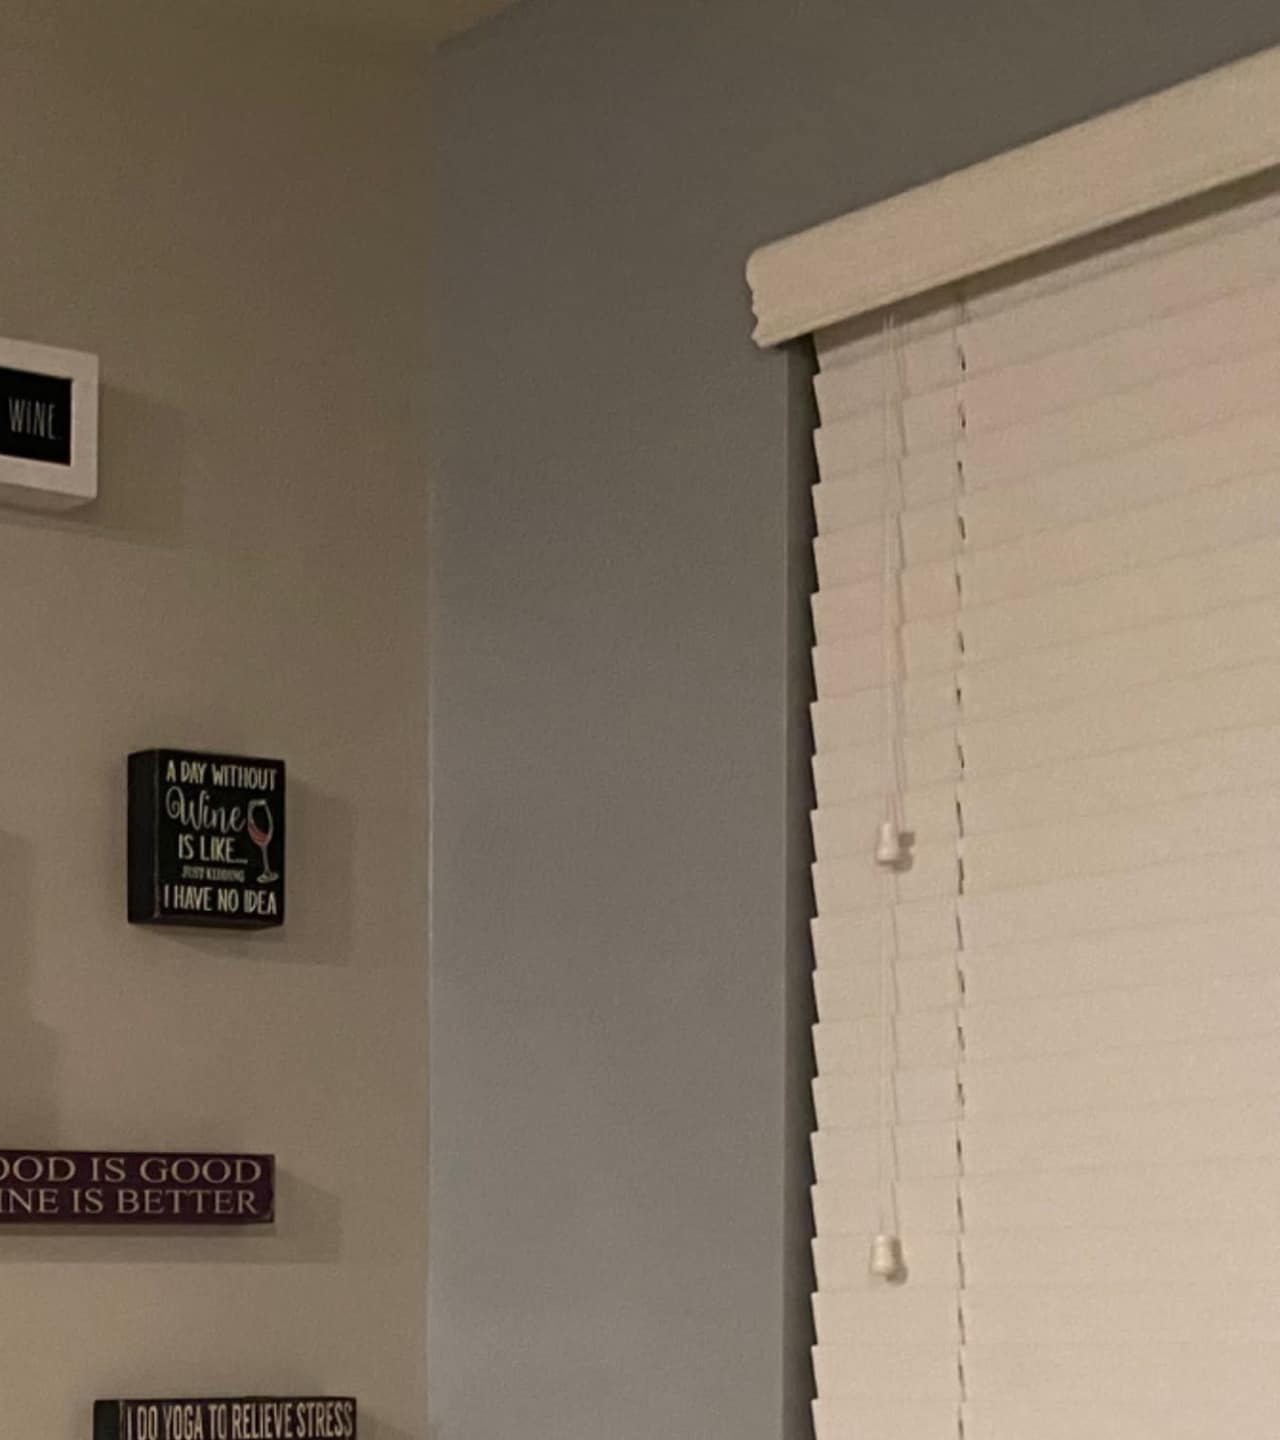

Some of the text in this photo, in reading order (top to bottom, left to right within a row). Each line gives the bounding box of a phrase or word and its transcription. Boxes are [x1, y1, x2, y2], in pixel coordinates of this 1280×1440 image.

[166, 760, 277, 791] A DAY WITHOUT
[165, 785, 247, 833] Wine
[178, 833, 194, 860] IS
[164, 884, 277, 915] I HAVE NO IDEA
[91, 1157, 126, 1182] IS
[140, 1158, 262, 1184] GOOD
[73, 1188, 104, 1214] IS
[117, 1189, 259, 1215] BETTER
[137, 1405, 157, 1440] DO
[163, 1404, 204, 1440] YOGA
[208, 1404, 228, 1440] TO
[232, 1403, 292, 1440] RELIEVE
[296, 1401, 353, 1438] STRESS
